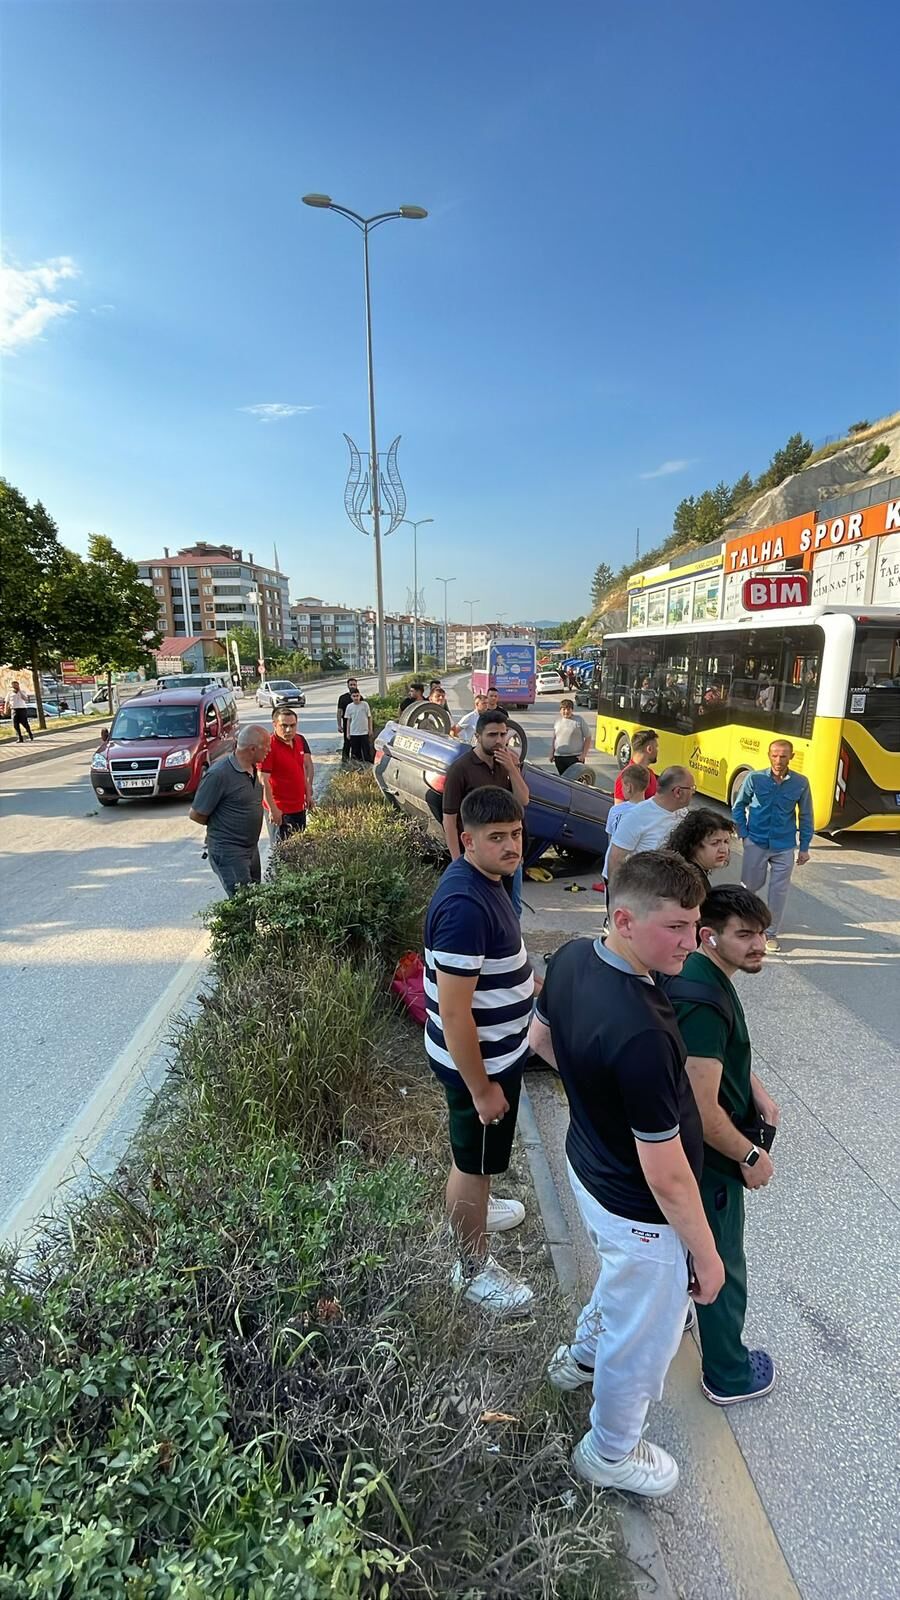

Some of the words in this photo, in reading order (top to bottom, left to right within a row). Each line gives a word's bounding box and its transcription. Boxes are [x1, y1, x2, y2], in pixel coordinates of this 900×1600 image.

[730, 536, 784, 569] TALHA
[799, 513, 864, 552] SPOR
[750, 578, 803, 605] BİM
